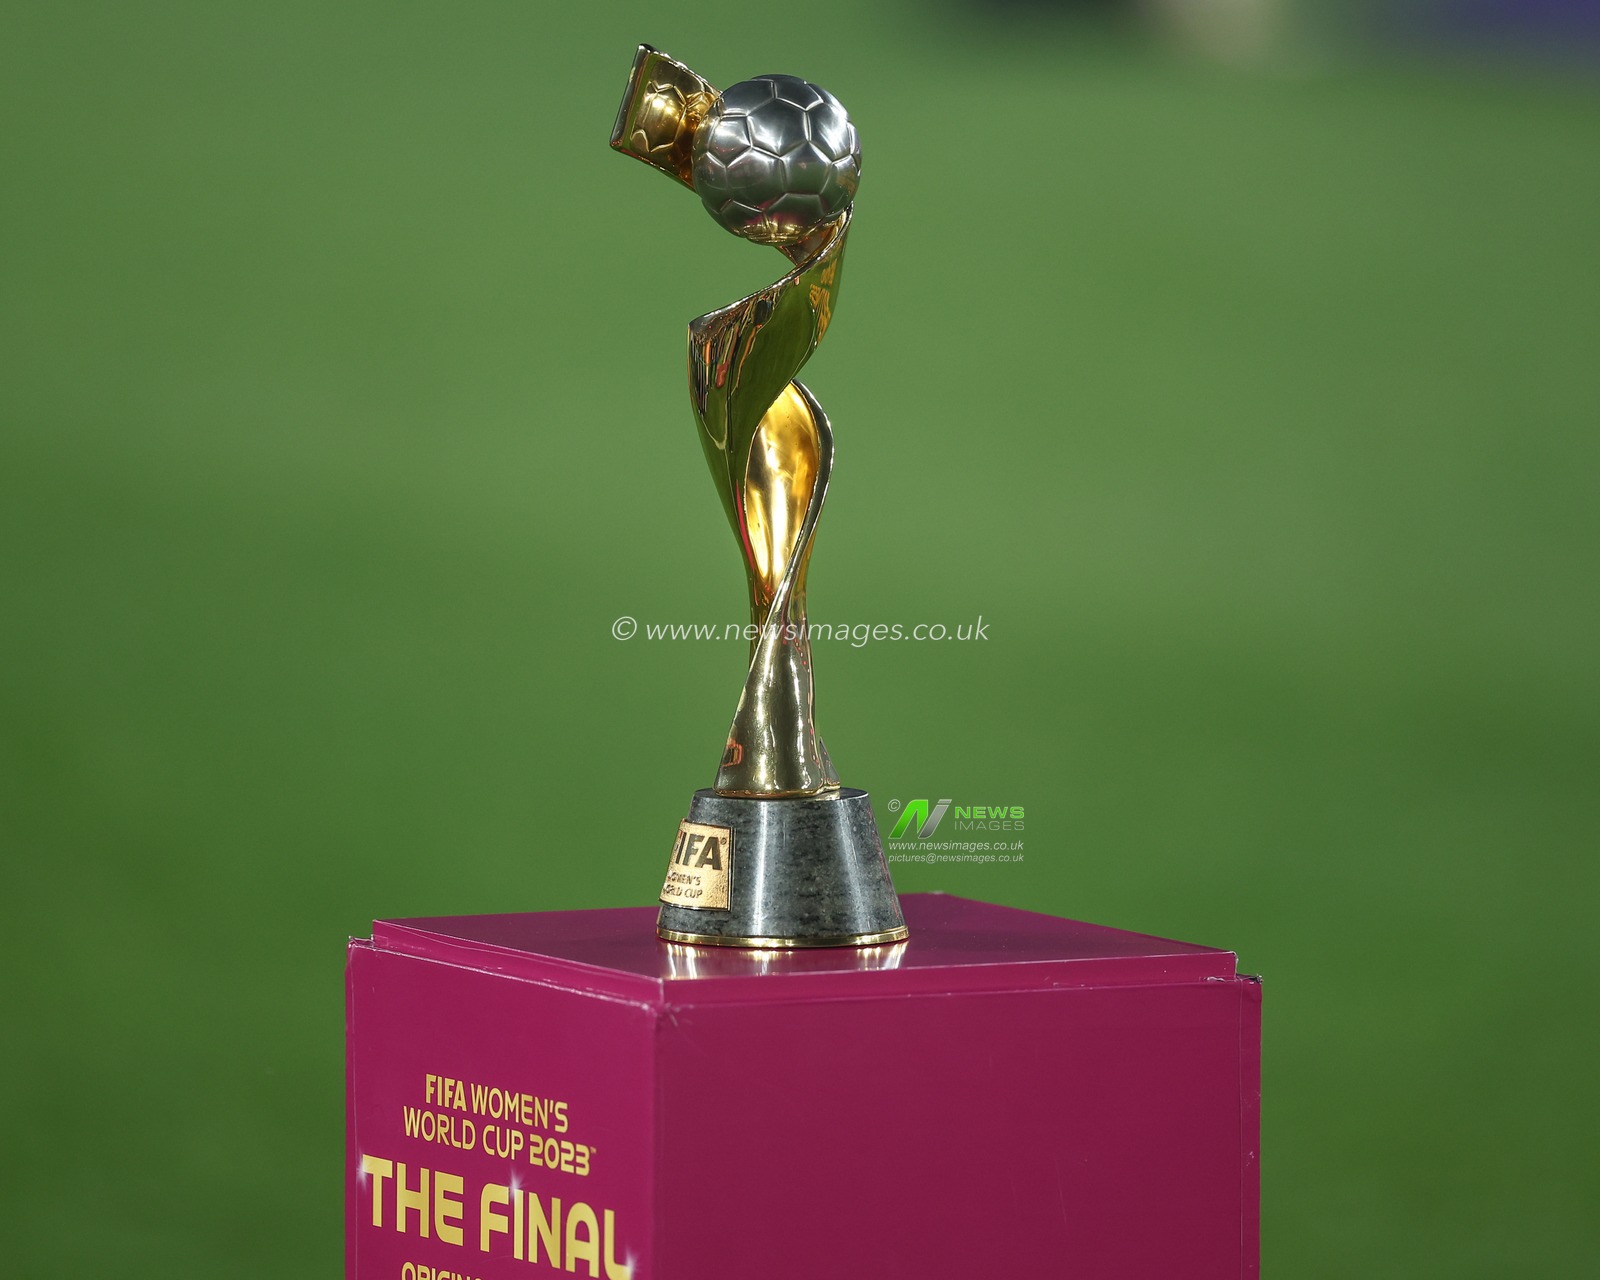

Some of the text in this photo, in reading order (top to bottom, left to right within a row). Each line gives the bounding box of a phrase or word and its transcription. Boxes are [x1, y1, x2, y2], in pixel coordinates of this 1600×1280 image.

[668, 872, 702, 885] OMEN'S
[684, 888, 703, 899] CUP
[425, 1074, 568, 1133] FIFA WOMEN'S
[403, 1106, 590, 1176] WORLD CUP 2023
[362, 1154, 633, 1280] THE FINAL
